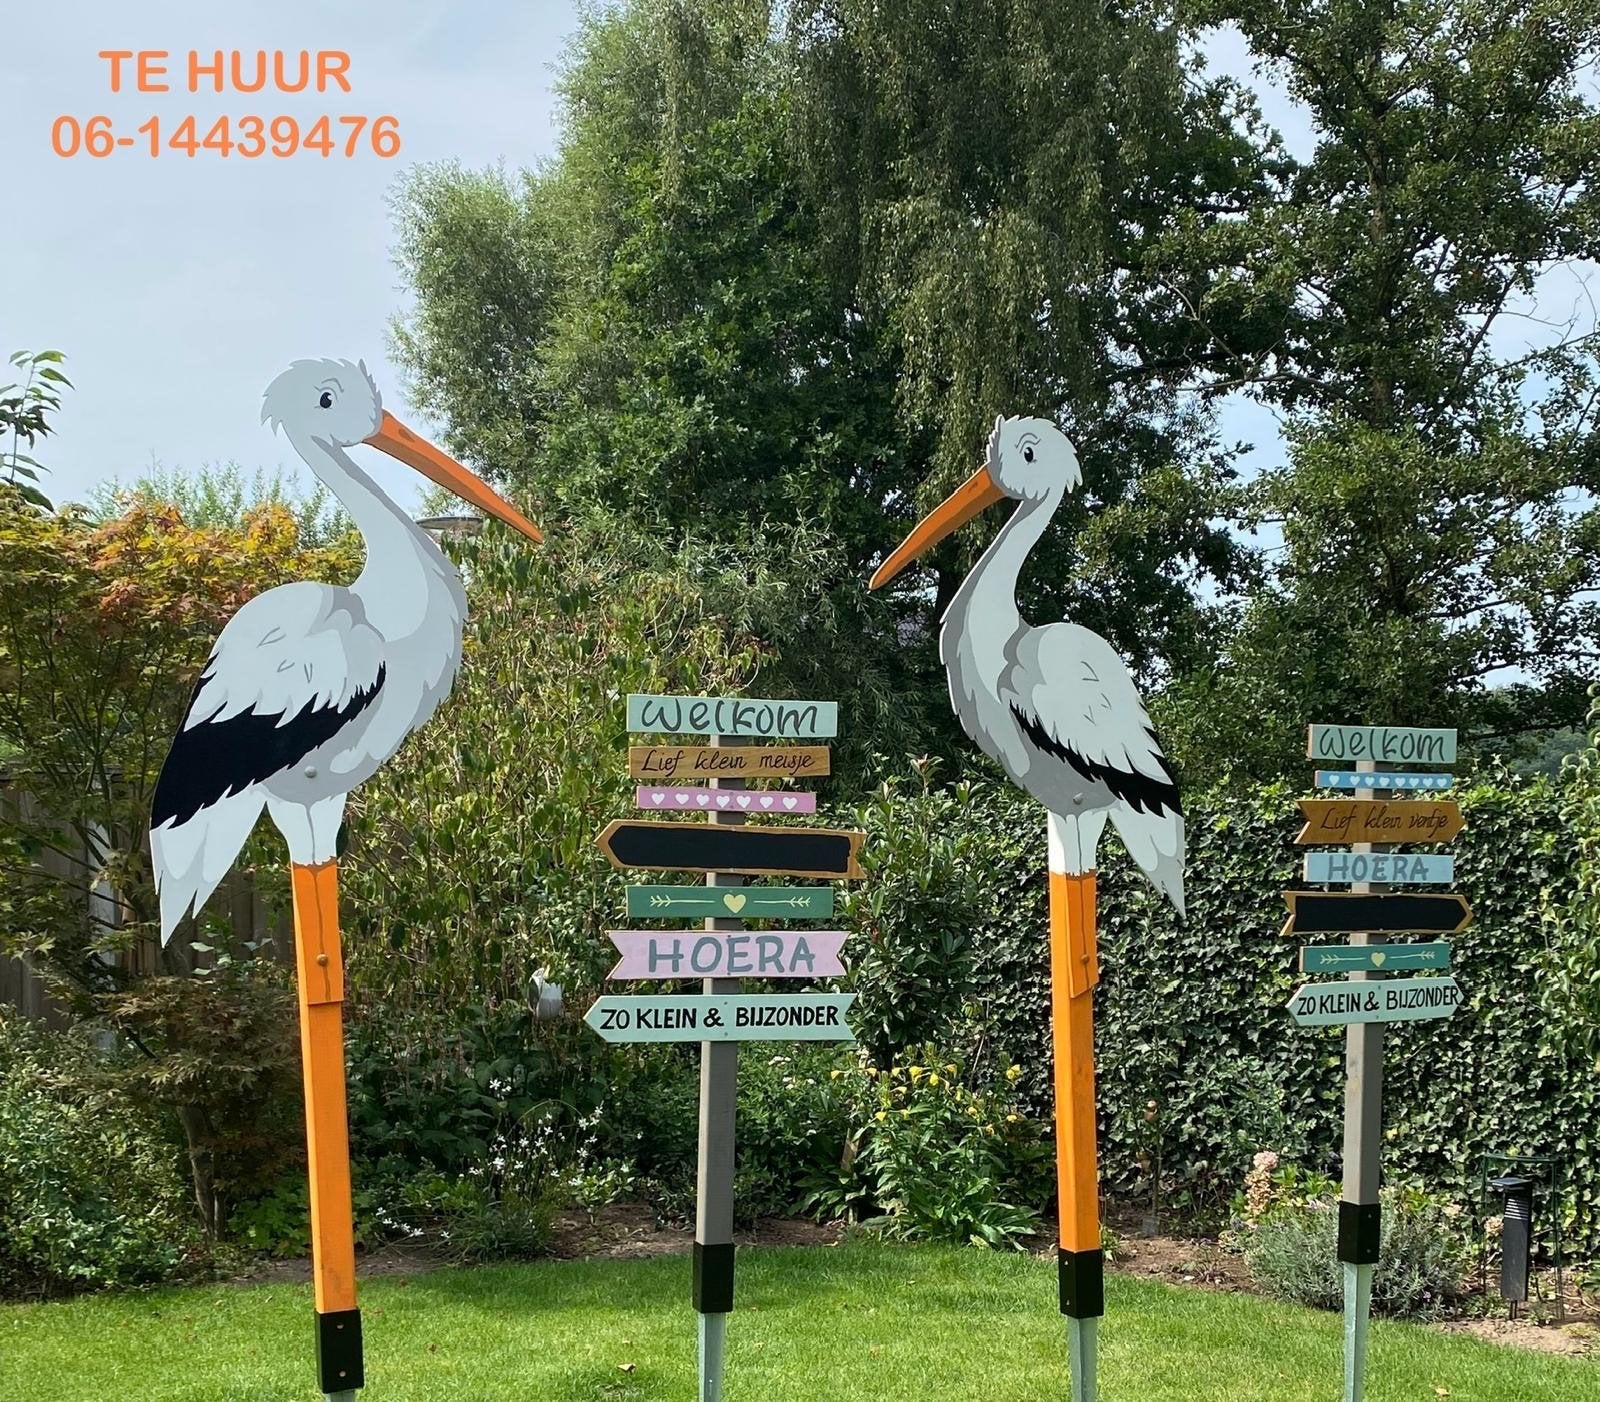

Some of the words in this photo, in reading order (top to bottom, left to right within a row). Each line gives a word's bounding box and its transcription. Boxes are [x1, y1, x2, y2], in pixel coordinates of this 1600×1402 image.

[641, 699, 818, 736] Welkom
[641, 749, 685, 777] Lief
[694, 751, 748, 770] klein
[758, 754, 815, 776] meisje
[1320, 804, 1357, 840] Lief
[1363, 806, 1403, 829] klein
[1408, 808, 1449, 839] ventje
[1327, 854, 1429, 882] HOERA
[648, 935, 816, 974] HOERA
[1297, 997, 1317, 1016] ZO
[1319, 992, 1361, 1015] KLEIN
[1363, 990, 1380, 1012] &
[1386, 985, 1460, 1011] BIJZONDER
[600, 1009, 631, 1030] ZO
[636, 1008, 697, 1029] KLEIN
[702, 1007, 725, 1028] &
[735, 1005, 839, 1027] BIJZONDER
